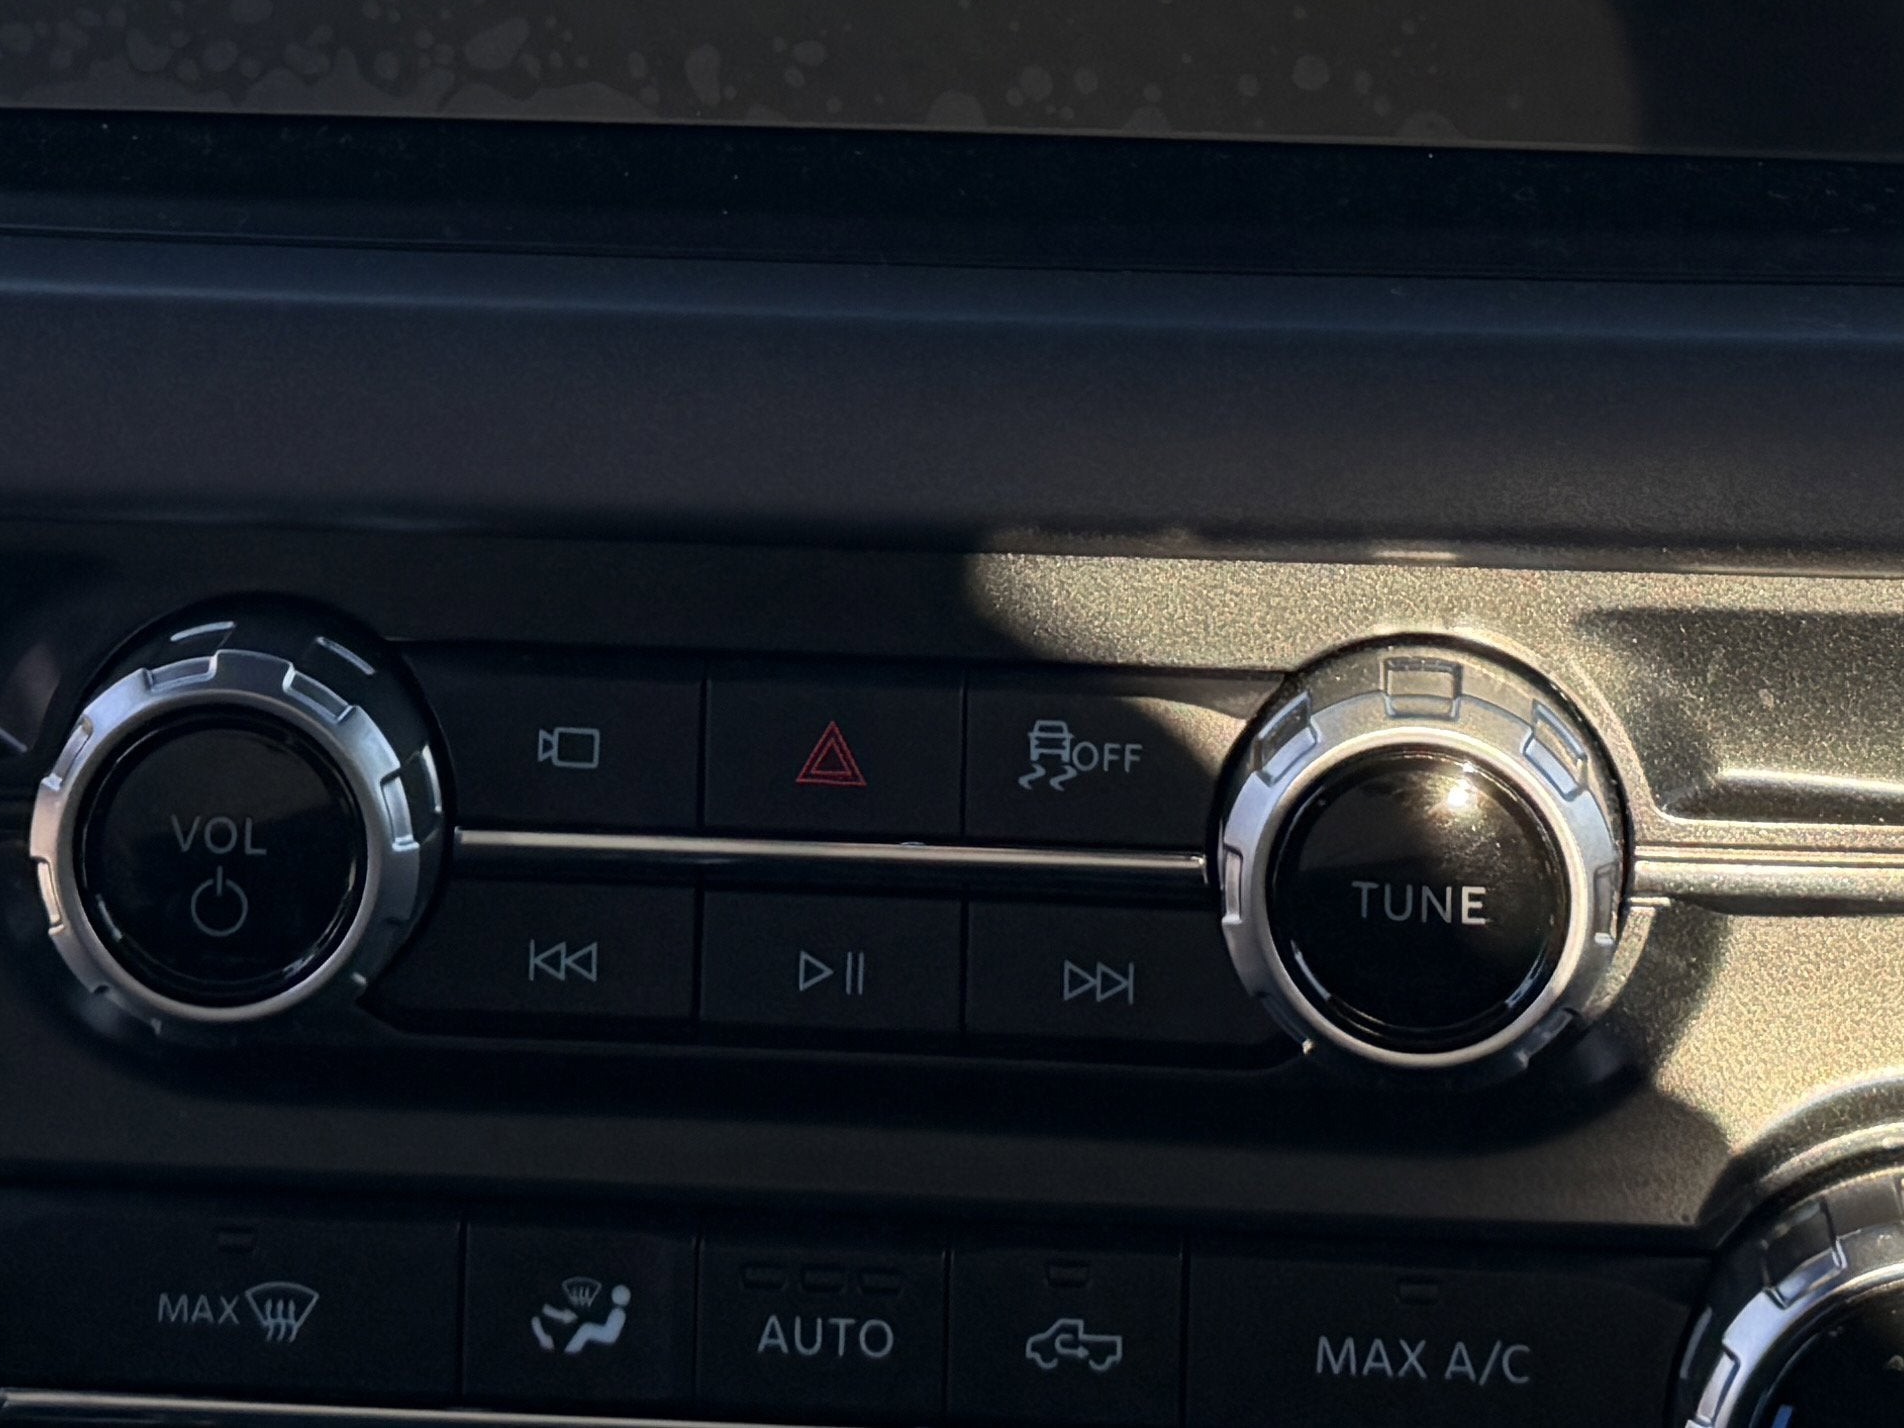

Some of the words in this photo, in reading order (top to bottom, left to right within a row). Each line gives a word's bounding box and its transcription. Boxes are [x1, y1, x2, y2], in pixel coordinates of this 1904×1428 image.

[1073, 744, 1143, 773] OFF
[171, 814, 267, 856] VOL
[1351, 880, 1488, 926] TUNE
[156, 1292, 240, 1326] MAX
[757, 1314, 894, 1358] AUTO
[1313, 1336, 1425, 1380] MAX
[1444, 1342, 1532, 1387] A/C
